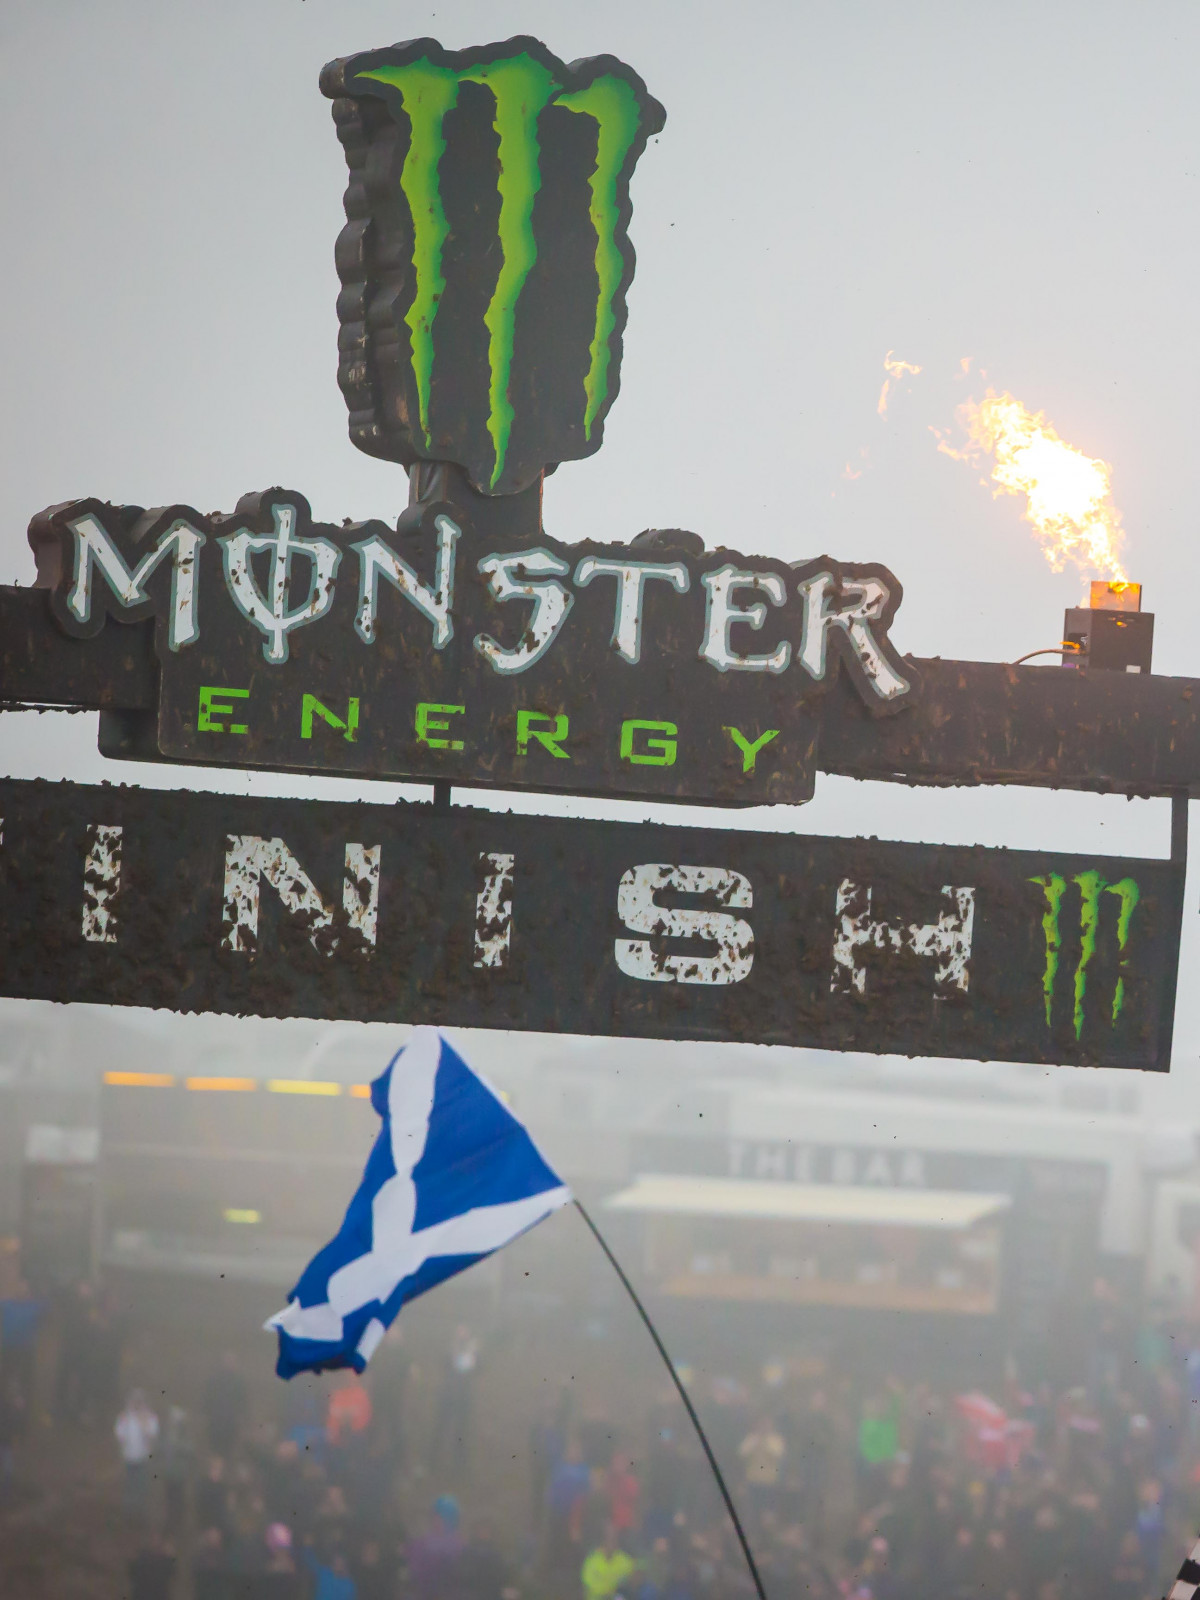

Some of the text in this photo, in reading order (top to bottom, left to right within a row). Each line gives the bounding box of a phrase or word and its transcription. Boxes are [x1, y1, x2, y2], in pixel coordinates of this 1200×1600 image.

[68, 503, 910, 700] MONSTER
[198, 686, 780, 772] ENERGY
[0, 817, 976, 999] INISH
